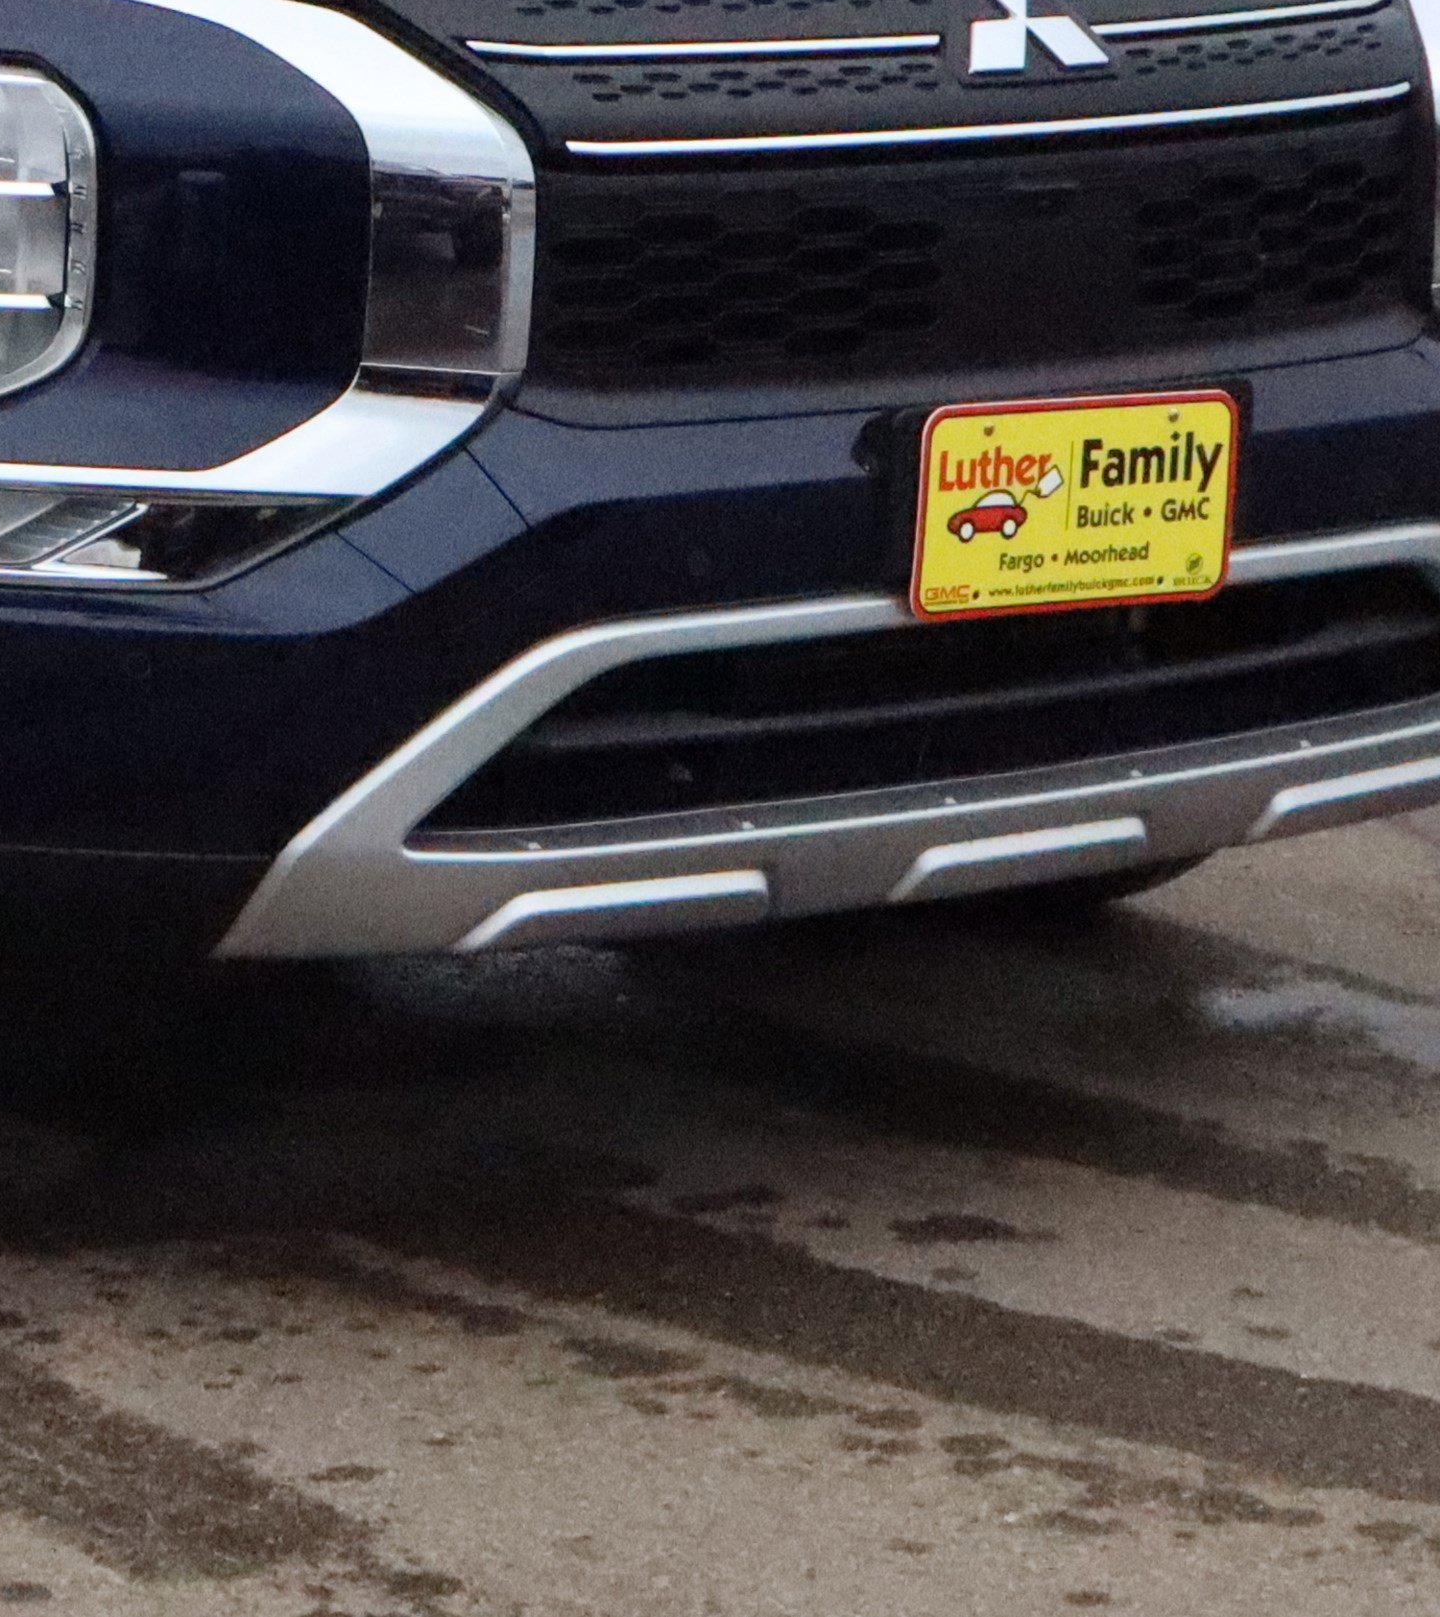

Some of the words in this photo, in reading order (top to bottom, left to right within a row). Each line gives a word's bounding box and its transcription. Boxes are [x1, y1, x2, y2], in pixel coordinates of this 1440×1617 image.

[938, 445, 1052, 492] Luther
[1080, 431, 1223, 492] Family
[1076, 501, 1134, 528] Buick
[1161, 496, 1211, 522] GMC
[999, 552, 1044, 573] Fargo
[1064, 541, 1150, 566] Moorhead
[925, 584, 970, 601] GMC
